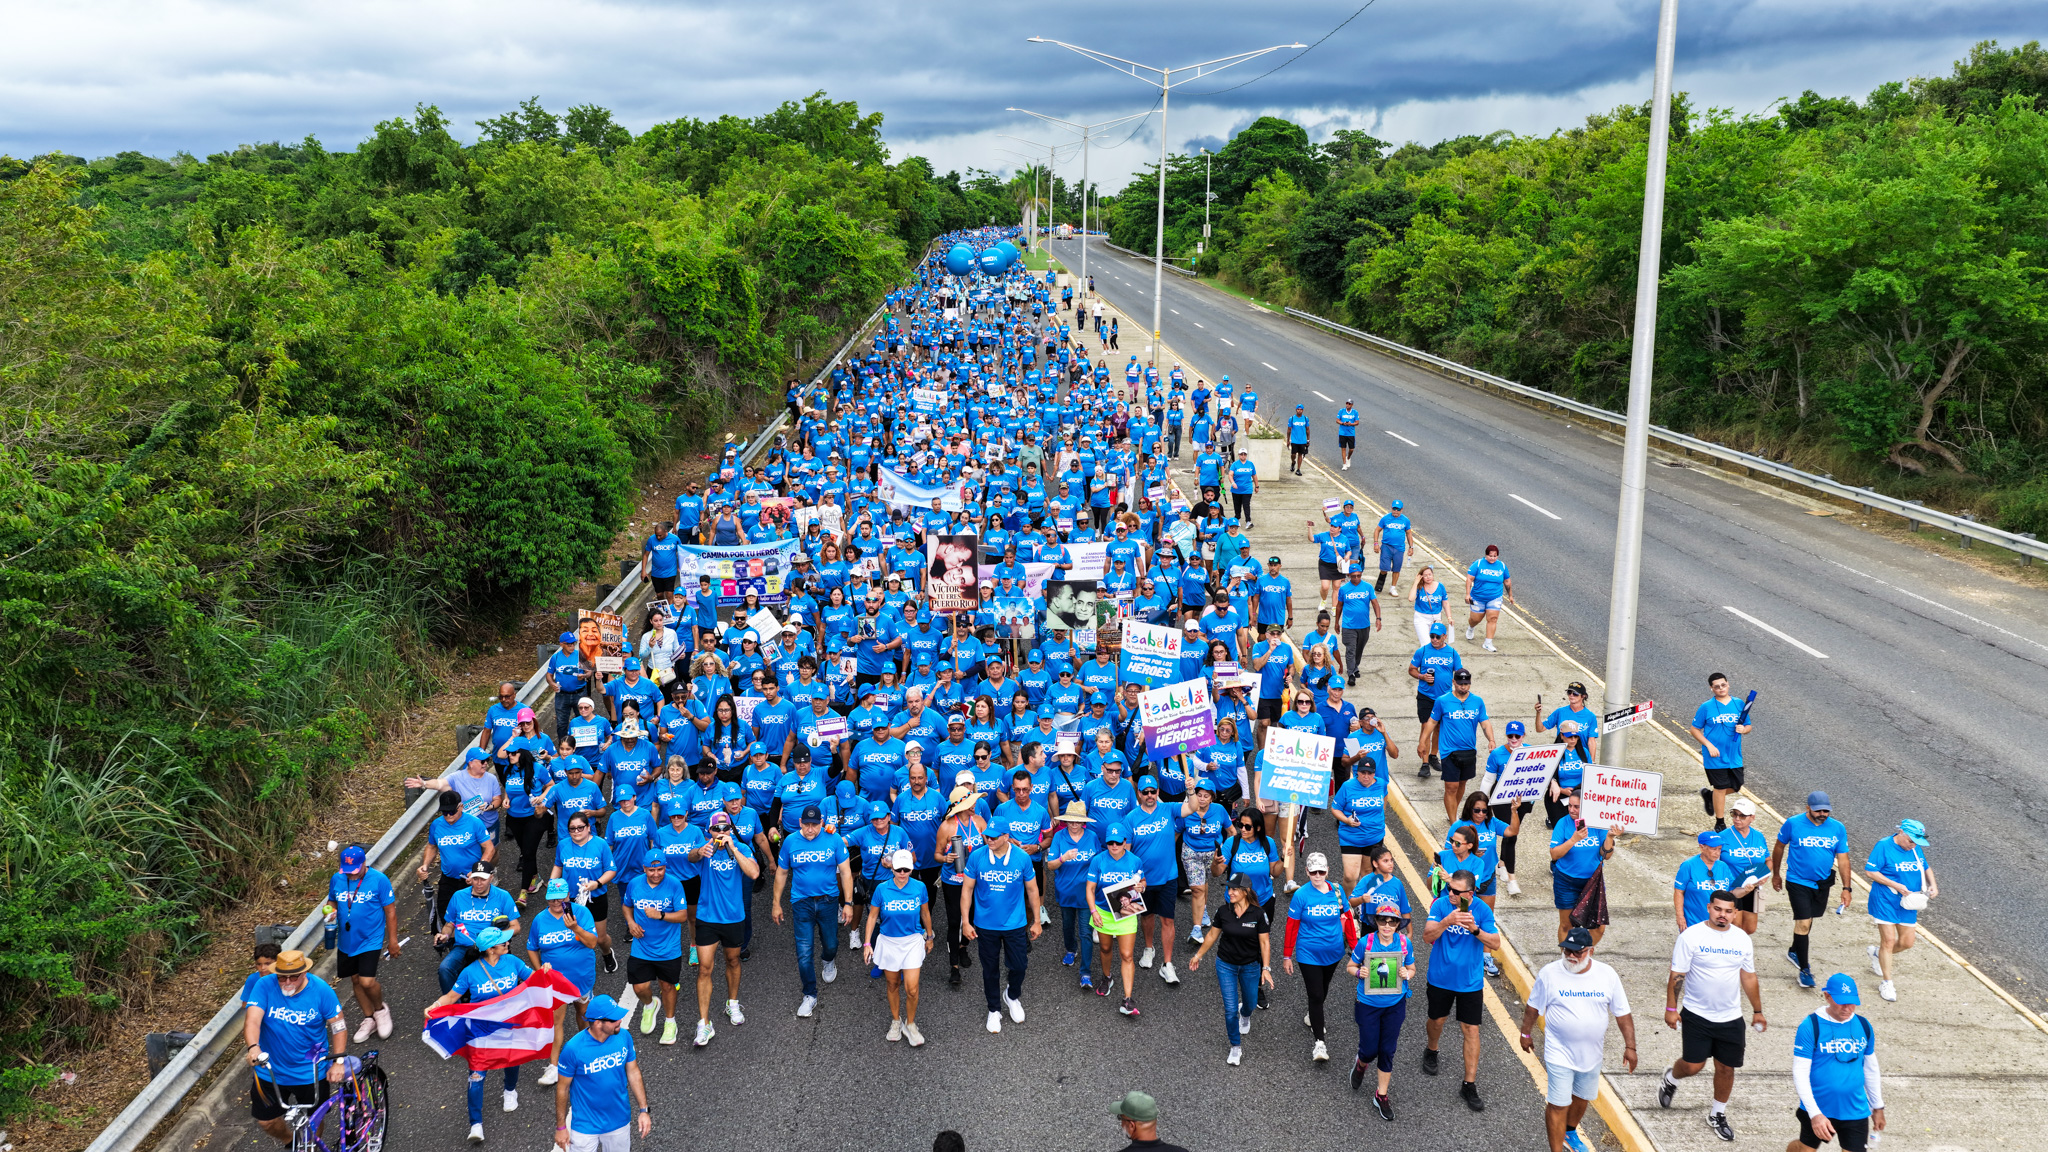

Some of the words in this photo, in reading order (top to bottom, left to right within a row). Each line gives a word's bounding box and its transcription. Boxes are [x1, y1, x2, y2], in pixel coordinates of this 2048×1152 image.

[701, 551, 729, 560] CAMINA
[756, 547, 780, 556] HÉROE
[931, 600, 959, 609] PUERTO
[959, 600, 977, 608] RICO
[1130, 655, 1151, 664] CAMINA
[1156, 722, 1179, 734] CAMINA
[1180, 719, 1192, 728] POR
[1193, 716, 1204, 725] LOS
[1154, 724, 1206, 749] HÉROES
[1514, 752, 1526, 762] El
[1525, 749, 1558, 761] AMOR
[1273, 767, 1298, 777] CAMINA
[1298, 771, 1311, 780] POR
[1311, 774, 1324, 782] LOS
[1513, 763, 1546, 776] puede
[1267, 775, 1323, 796] HÉROES
[1503, 776, 1524, 787] más
[1526, 776, 1545, 787] que
[1596, 773, 1608, 785] Tu
[1610, 774, 1648, 791] familia
[1496, 790, 1507, 800] el
[1508, 788, 1540, 799] olvido.
[1583, 790, 1622, 807] siempre
[1624, 797, 1657, 809] estará
[1598, 810, 1638, 827] contigo.
[1799, 836, 1832, 848] HÉROE
[793, 851, 825, 863] HÉROE
[980, 870, 1012, 883] HÉROE
[884, 900, 915, 911] HÉROE
[1699, 944, 1743, 956] Voluntarios
[1558, 989, 1605, 998] Voluntarios
[1819, 1039, 1860, 1054] HÉROE
[583, 1055, 623, 1075] HÉROE
